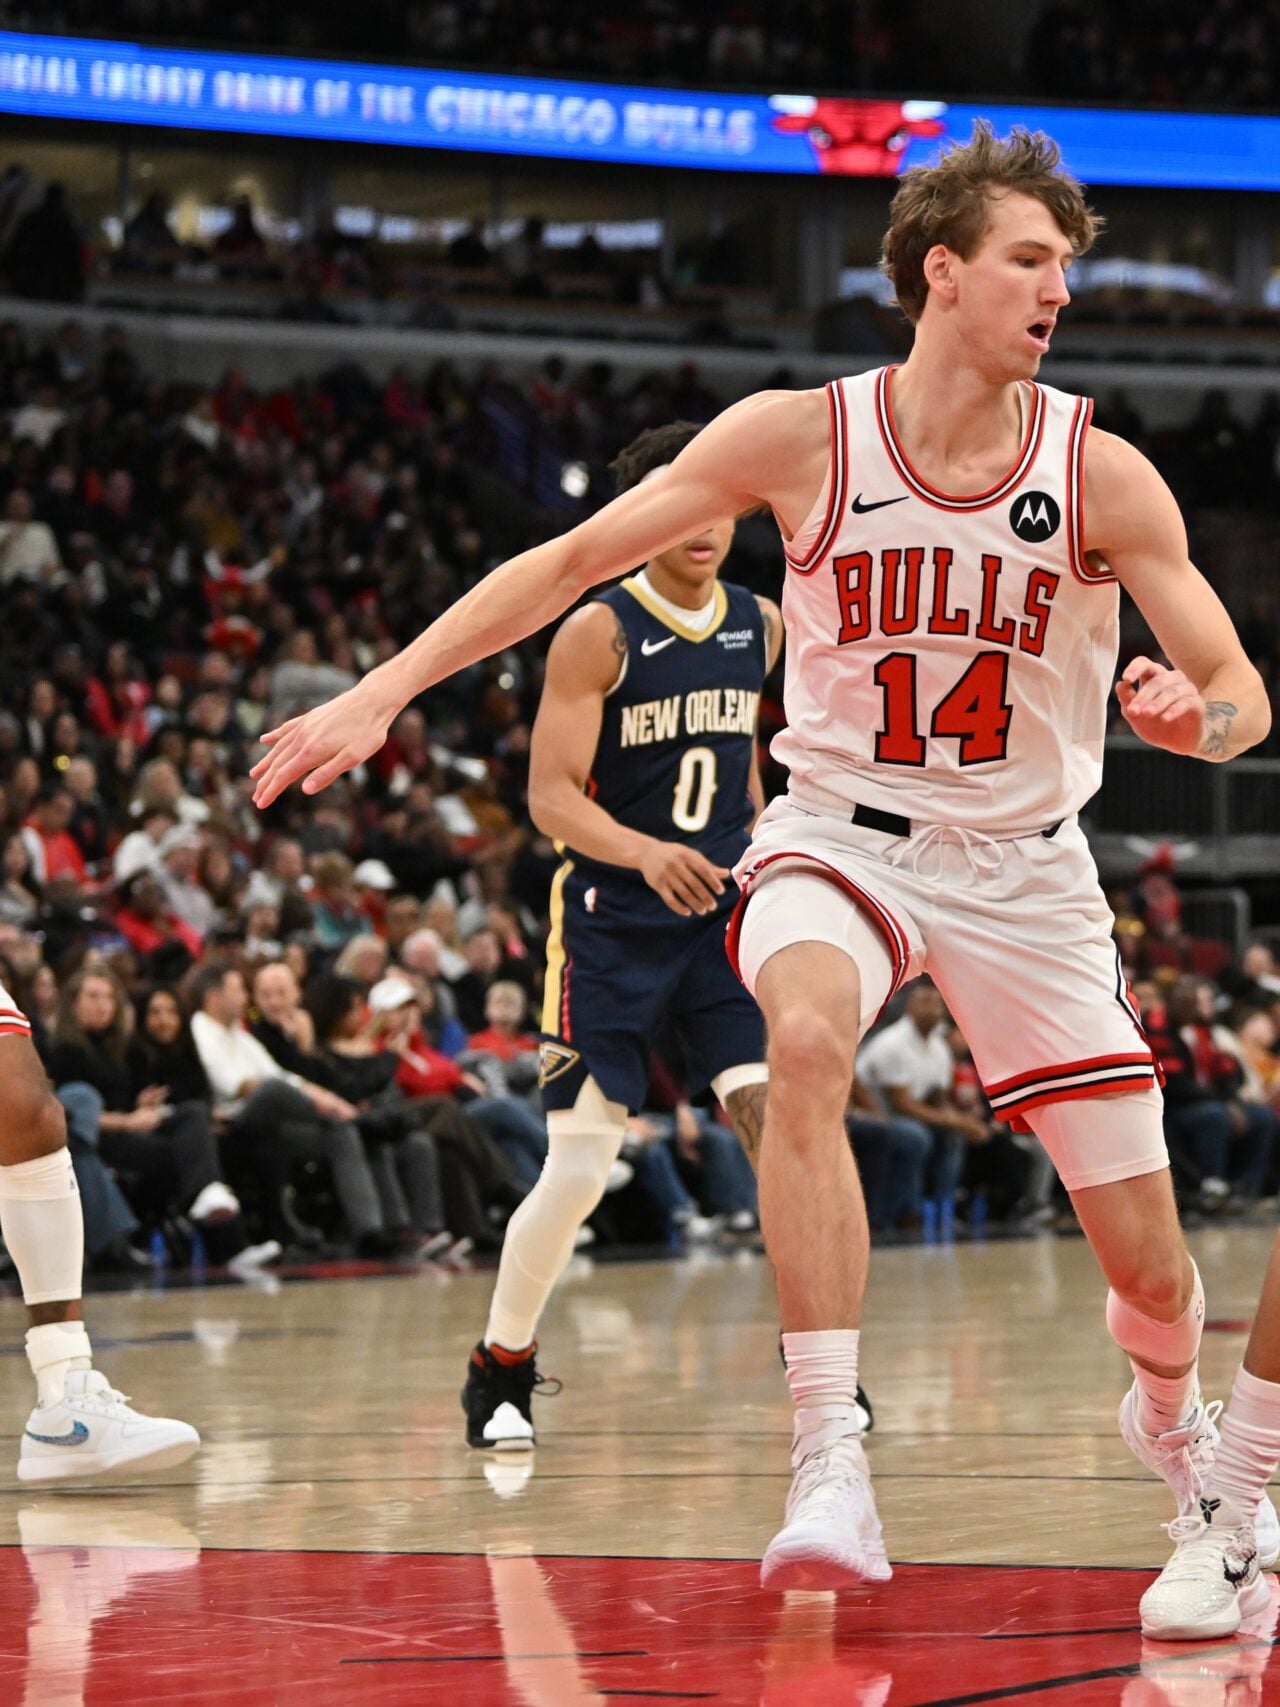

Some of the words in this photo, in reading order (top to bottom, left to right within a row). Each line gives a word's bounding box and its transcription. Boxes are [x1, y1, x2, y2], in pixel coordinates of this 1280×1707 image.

[425, 85, 617, 146] CHICAGO
[623, 101, 757, 155] BULLS
[716, 629, 753, 642] NEWAGE
[833, 547, 1061, 658] BULLS
[620, 695, 682, 748] NEW
[873, 650, 1014, 768] 14
[671, 746, 718, 833] 0
